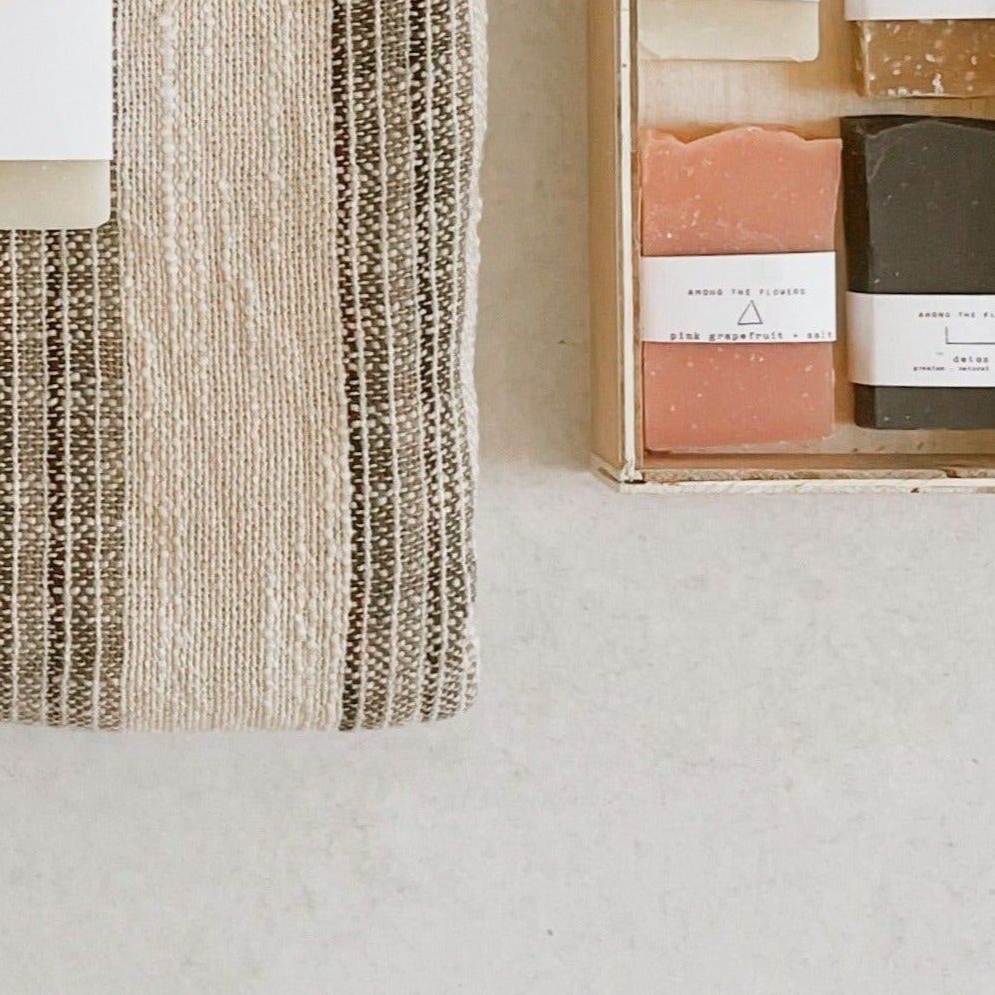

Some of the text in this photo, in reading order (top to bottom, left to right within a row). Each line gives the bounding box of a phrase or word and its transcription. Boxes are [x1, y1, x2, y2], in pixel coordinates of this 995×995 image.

[759, 288, 806, 296] FLOWERS
[670, 332, 700, 341] pink
[708, 332, 784, 342] grapefruit
